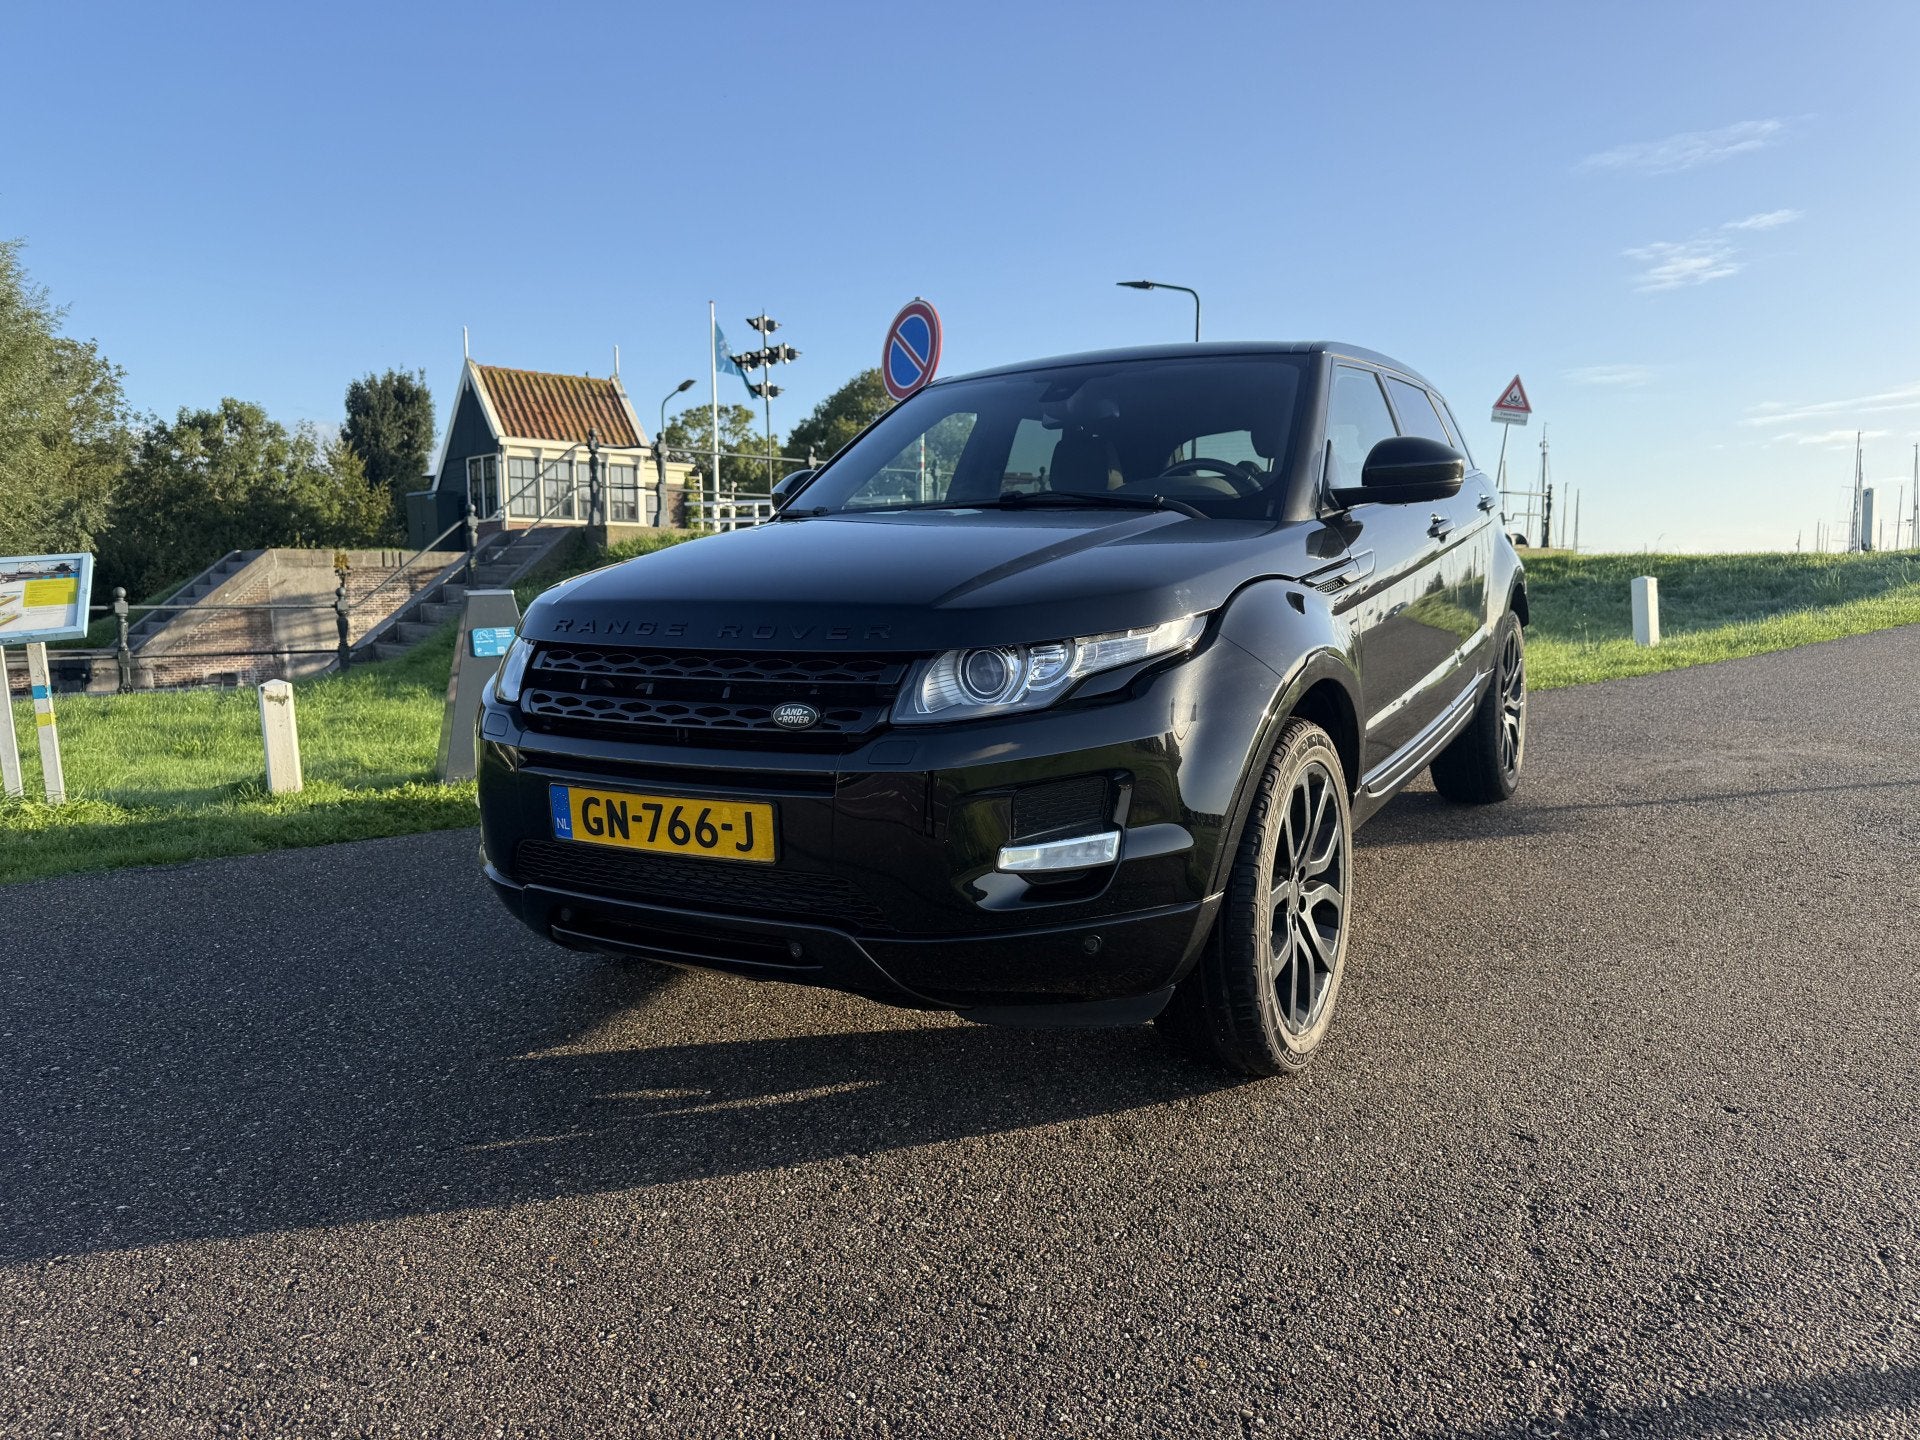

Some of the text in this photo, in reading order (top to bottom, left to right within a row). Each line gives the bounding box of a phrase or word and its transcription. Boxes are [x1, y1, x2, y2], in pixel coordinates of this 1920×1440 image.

[548, 618, 892, 641] RANGE ROVER
[782, 715, 810, 724] ROVER
[556, 816, 570, 830] NL
[581, 796, 754, 852] GN-766-J
